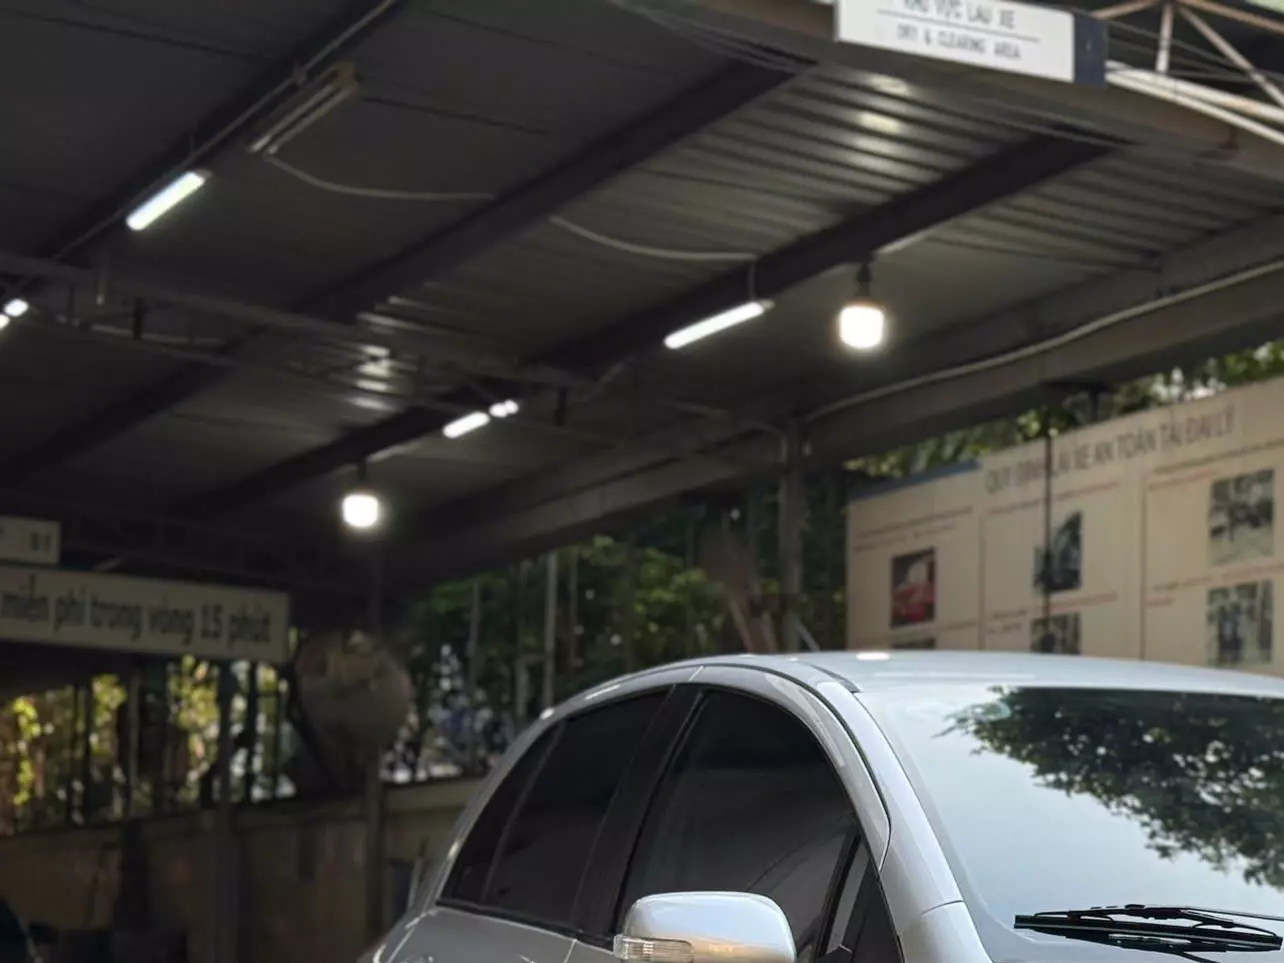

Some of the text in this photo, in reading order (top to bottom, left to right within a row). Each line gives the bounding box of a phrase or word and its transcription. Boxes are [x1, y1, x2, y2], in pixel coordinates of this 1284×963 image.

[924, 27, 932, 46] &
[993, 39, 1022, 60] AREA
[201, 602, 224, 639] 15
